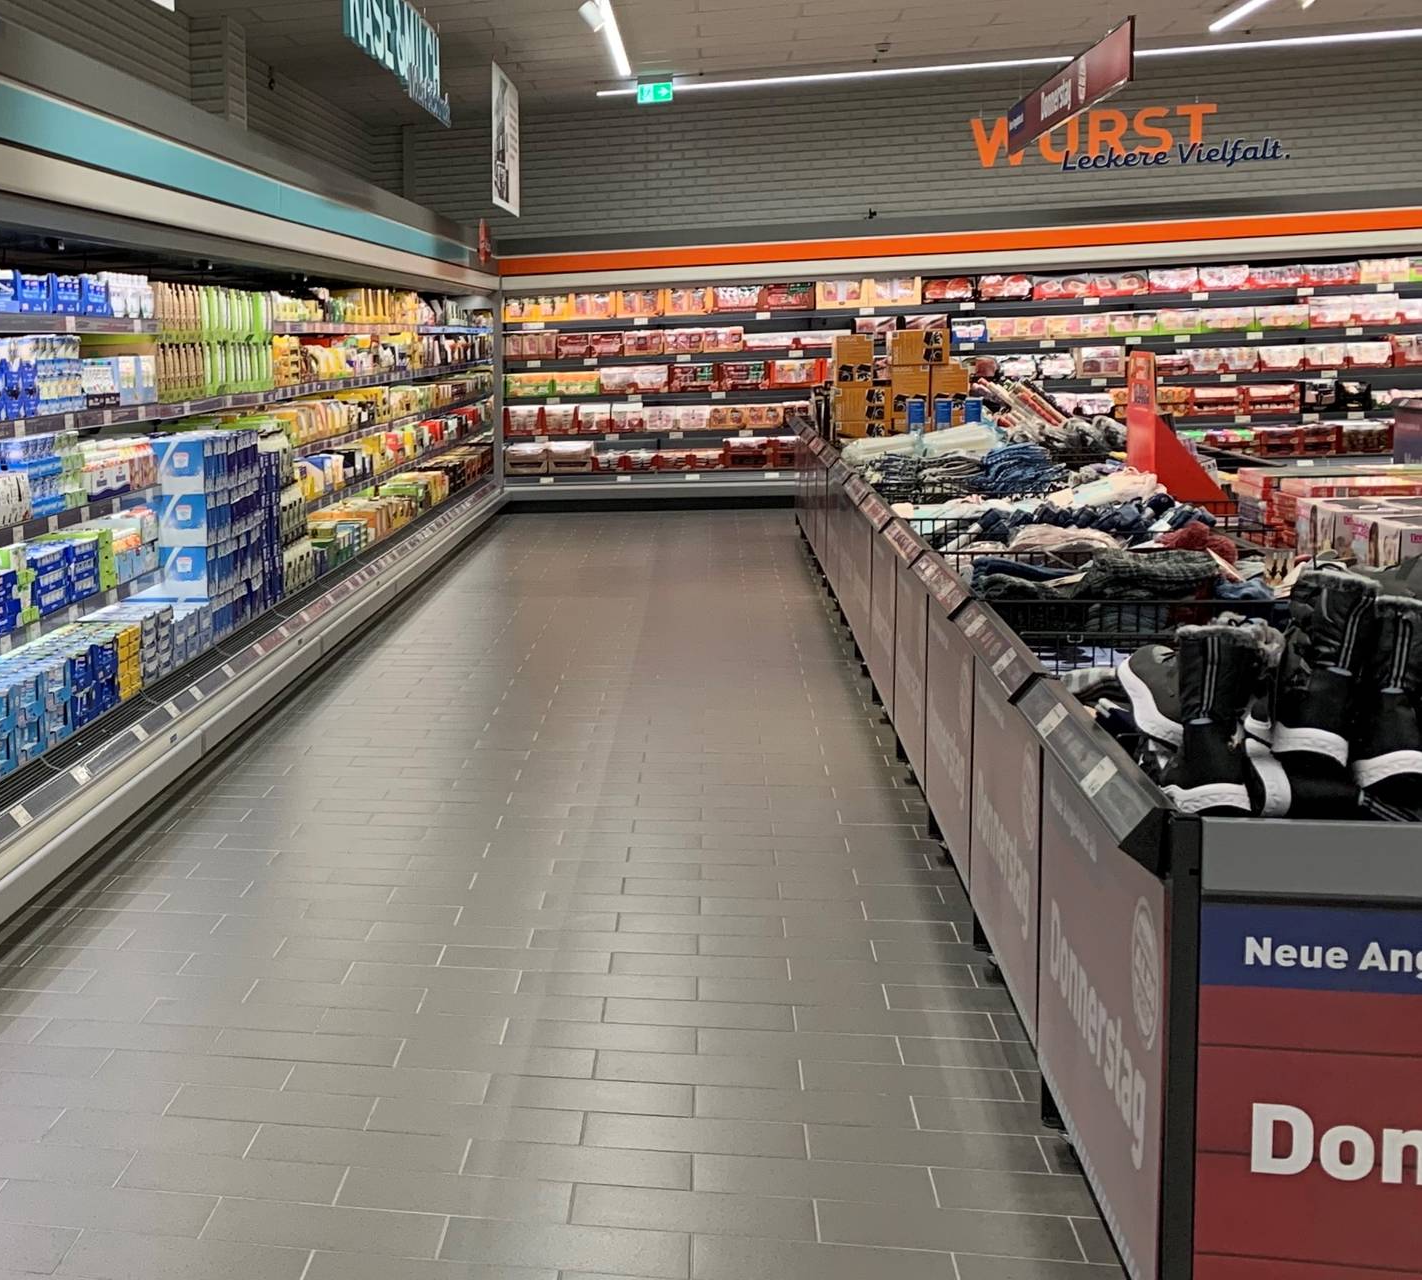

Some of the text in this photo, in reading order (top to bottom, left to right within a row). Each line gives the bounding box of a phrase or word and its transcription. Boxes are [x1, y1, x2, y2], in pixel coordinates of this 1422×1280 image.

[1061, 137, 1291, 172] Leckere Vielfalt.
[1244, 935, 1350, 971] Neue
[1050, 899, 1147, 1170] Donnerstag
